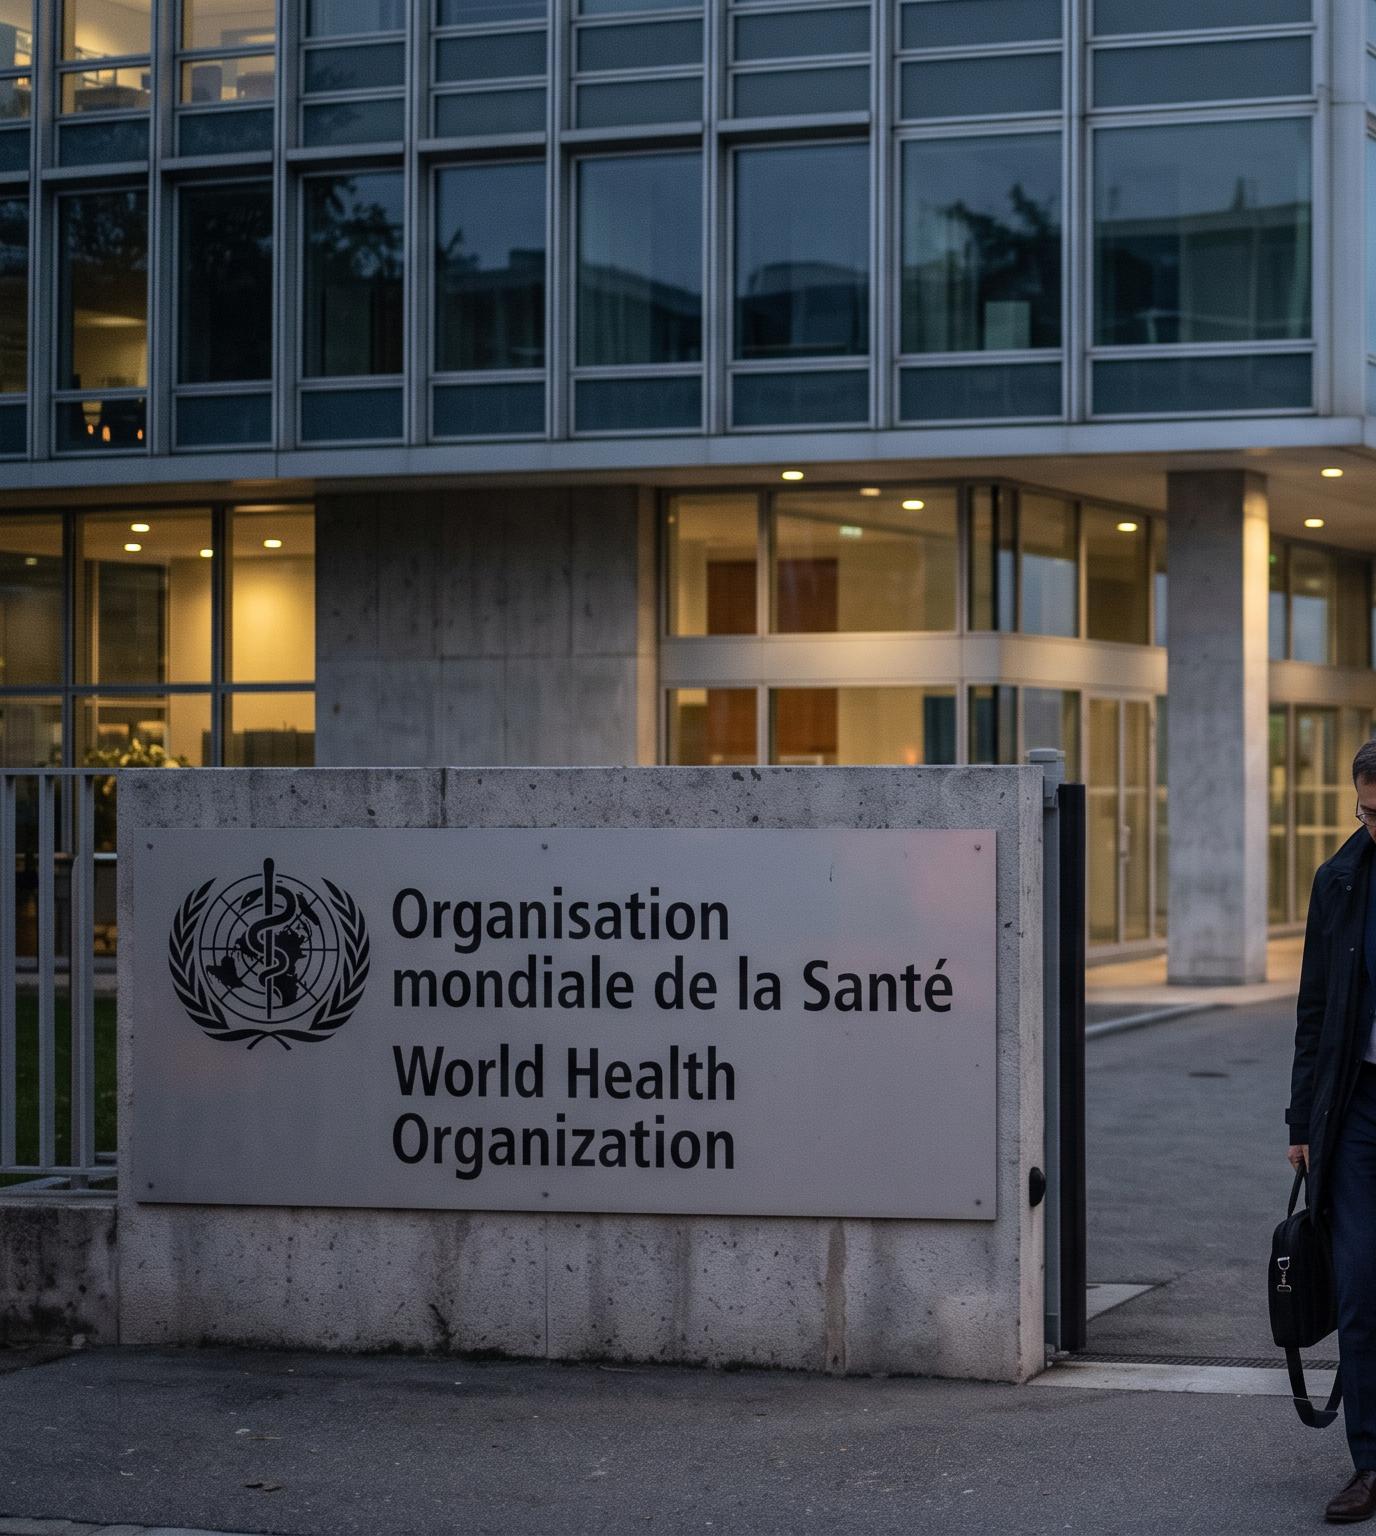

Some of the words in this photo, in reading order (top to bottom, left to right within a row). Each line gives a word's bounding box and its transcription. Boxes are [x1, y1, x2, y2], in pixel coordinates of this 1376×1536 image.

[391, 886, 729, 955] Organisation
[393, 954, 632, 1010] mondiale
[654, 954, 718, 1011] de
[739, 955, 782, 1012] la
[803, 958, 953, 1013] Santé
[391, 1043, 545, 1099] World
[567, 1045, 736, 1101] Health
[391, 1112, 735, 1182] Organization
